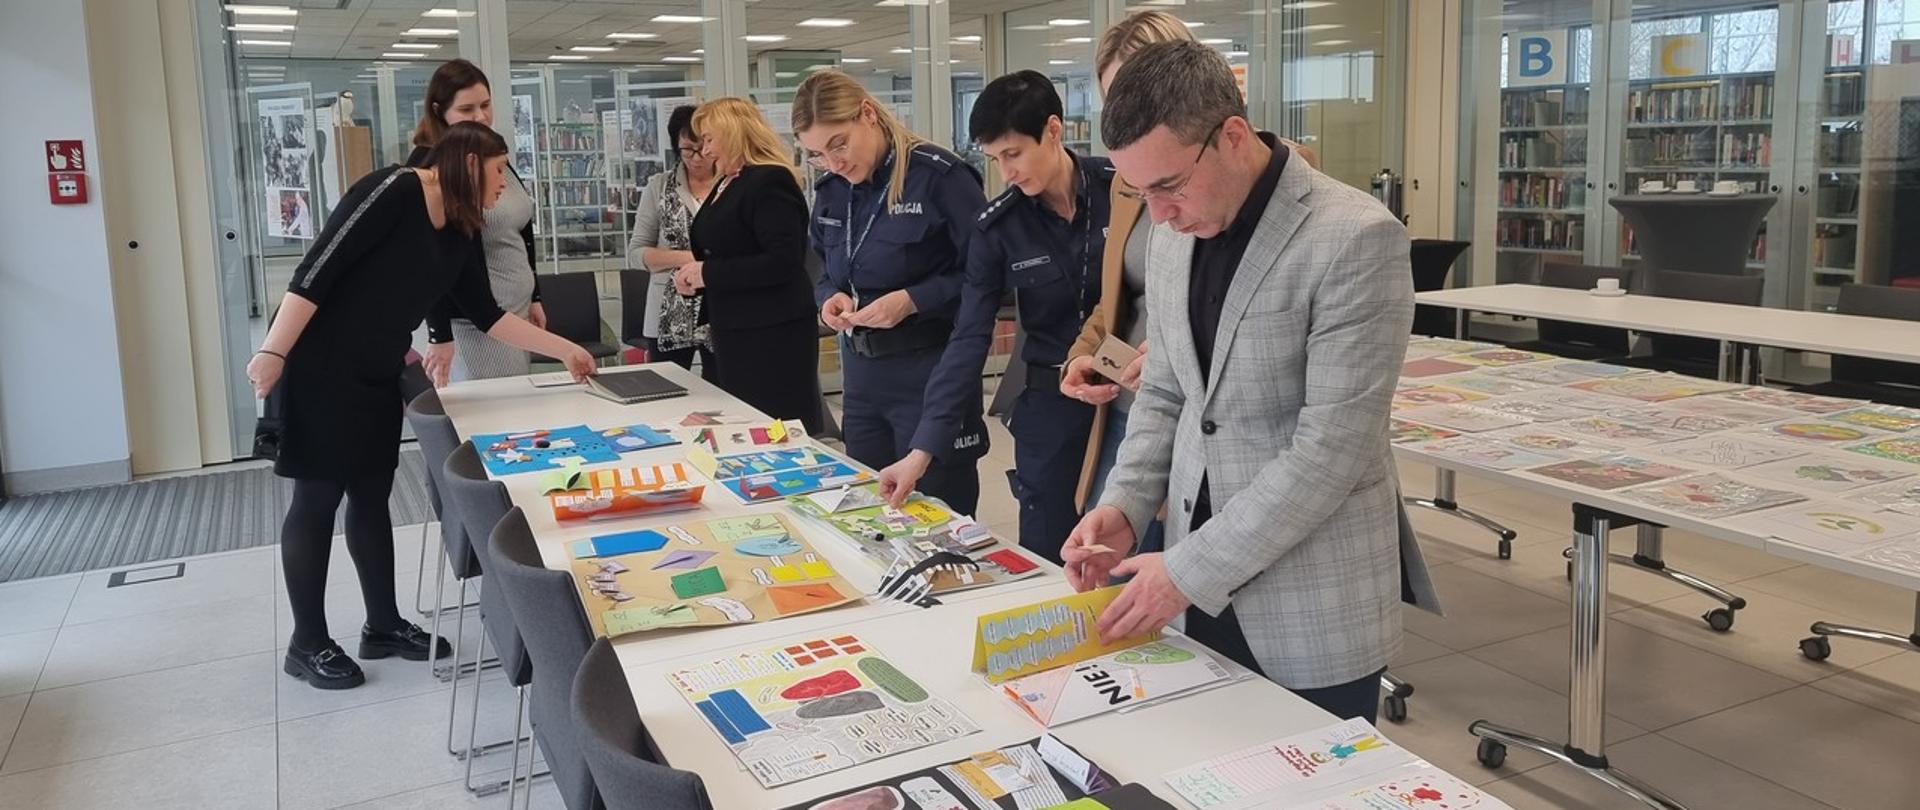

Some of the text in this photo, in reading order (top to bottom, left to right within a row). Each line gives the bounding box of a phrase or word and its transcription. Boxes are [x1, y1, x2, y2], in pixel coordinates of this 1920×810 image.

[1519, 36, 1554, 78] B
[1661, 36, 1698, 76] C
[1074, 663, 1132, 706] NIE!
